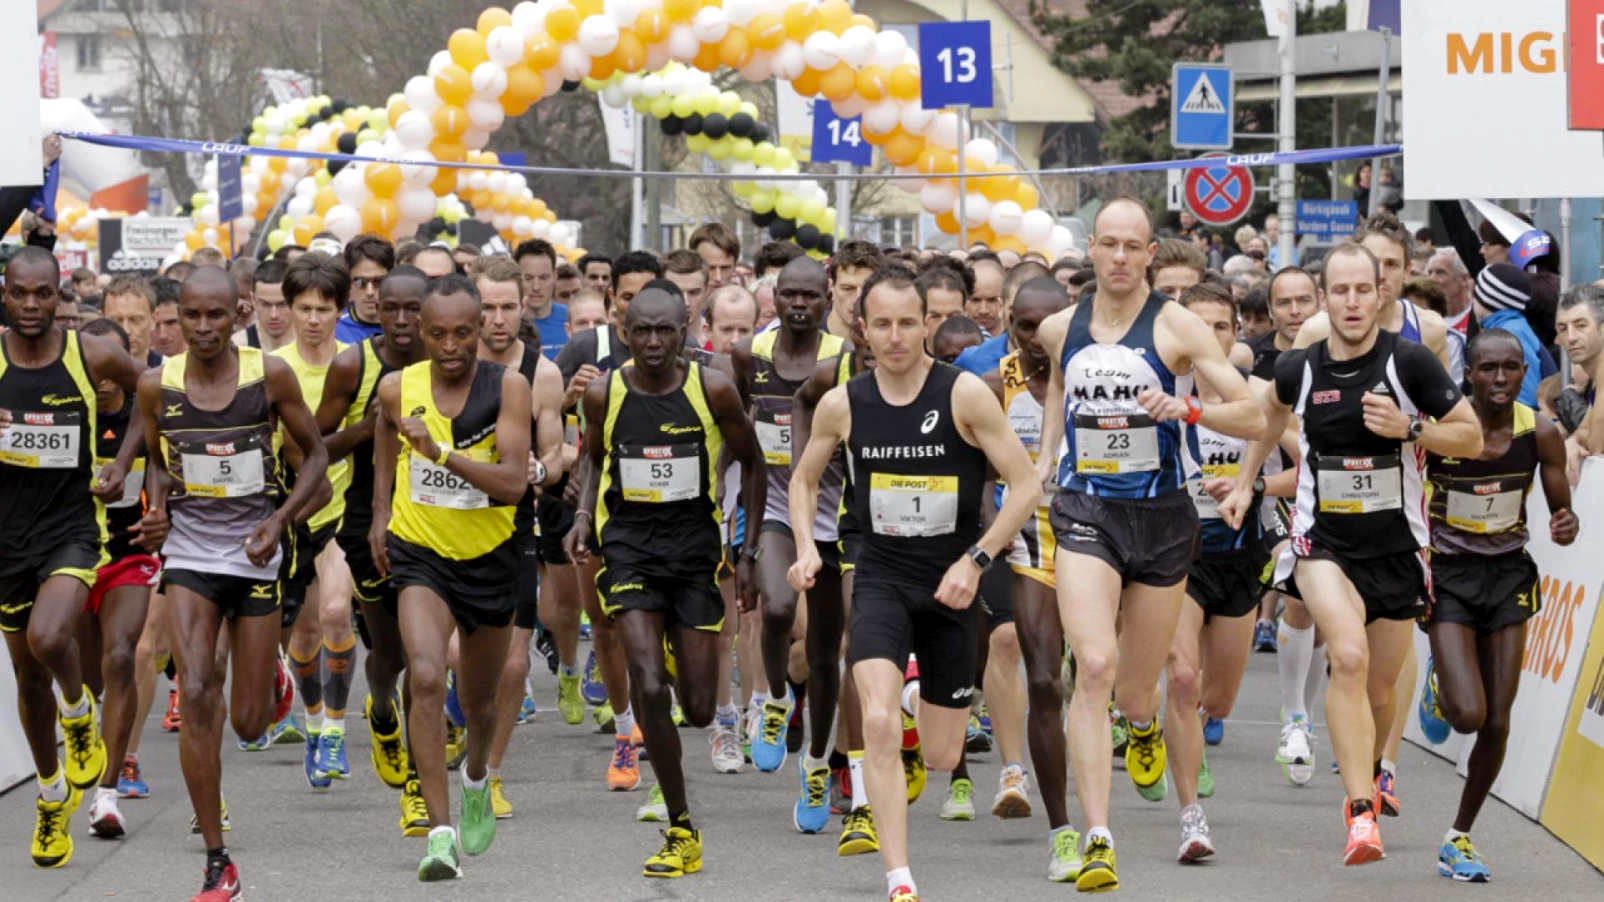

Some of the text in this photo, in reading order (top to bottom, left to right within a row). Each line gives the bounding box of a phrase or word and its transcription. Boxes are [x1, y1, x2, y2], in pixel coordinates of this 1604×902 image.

[1446, 31, 1566, 74] MIG
[936, 46, 977, 83] 13
[827, 119, 861, 147] 14
[11, 432, 70, 450] 28361
[1106, 432, 1131, 450] 23
[861, 444, 946, 459] RAIFFEISEN
[219, 460, 231, 475] 5
[651, 463, 673, 479] 53
[421, 468, 472, 490] 2862
[890, 480, 928, 488] DIE POST
[1352, 475, 1373, 490] 31
[911, 496, 921, 513] 1
[1485, 497, 1495, 512] 7
